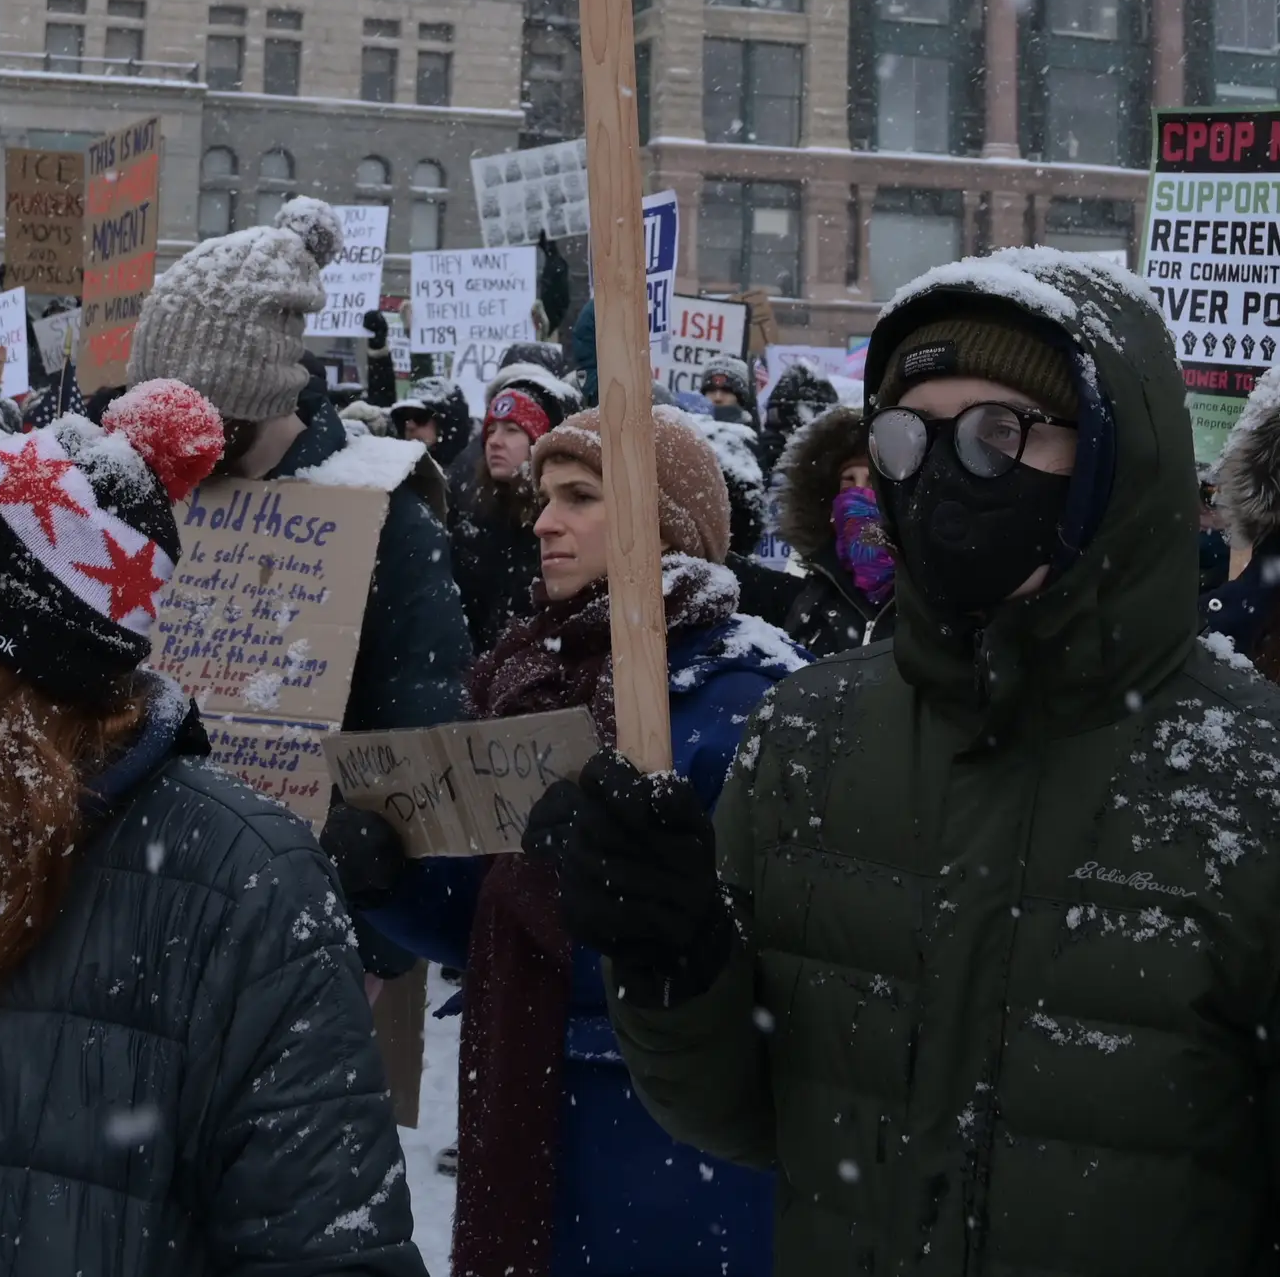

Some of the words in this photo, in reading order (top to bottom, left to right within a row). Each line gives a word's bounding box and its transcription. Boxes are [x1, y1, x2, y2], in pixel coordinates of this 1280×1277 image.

[88, 135, 116, 176] THIS
[120, 129, 132, 162] IS
[132, 117, 158, 158] NOT
[1162, 121, 1256, 163] CPOP
[22, 155, 76, 185] ICE
[6, 192, 84, 219] MURDERS
[344, 208, 368, 224] YOU
[16, 225, 73, 245] MOMS
[91, 202, 150, 263] MOMENT
[27, 248, 58, 264] AND
[427, 253, 464, 274] THEY
[470, 252, 510, 271] WANT
[352, 273, 376, 284] NOT
[1147, 259, 1182, 280] FOR
[326, 292, 366, 310] ING
[415, 279, 455, 299] 1939
[477, 298, 509, 318] GET
[419, 325, 458, 347] 1789
[469, 320, 530, 342] FRANCE!
[1192, 403, 1218, 412] ance
[184, 487, 253, 532] hold
[252, 491, 337, 547] these
[190, 540, 206, 564] be
[178, 568, 240, 592] created
[287, 582, 328, 606] that
[158, 618, 205, 639] with
[211, 622, 284, 646] certain
[225, 645, 269, 666] that
[208, 728, 258, 750] these
[264, 735, 322, 757] rights,
[211, 747, 300, 772] nstituted
[336, 743, 412, 792] America,
[466, 735, 557, 787] LOOK
[274, 777, 320, 798] just
